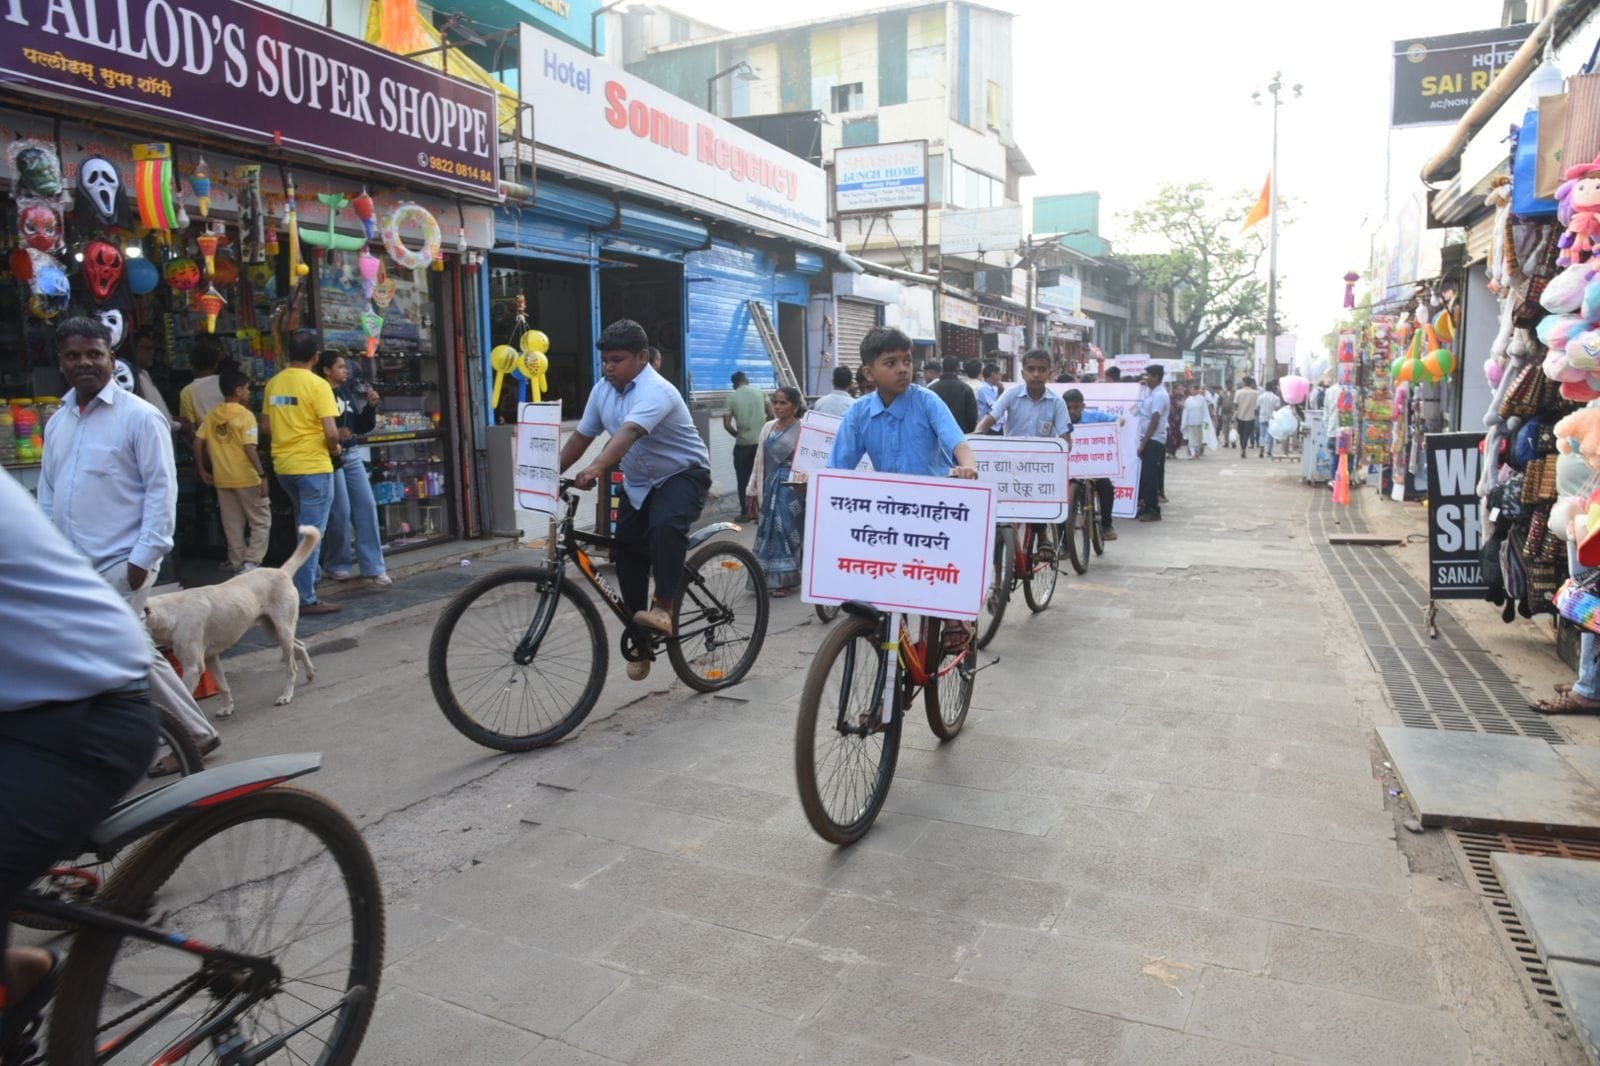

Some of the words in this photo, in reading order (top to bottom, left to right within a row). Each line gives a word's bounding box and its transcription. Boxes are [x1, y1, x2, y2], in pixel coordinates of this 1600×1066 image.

[543, 48, 591, 95] Hotel
[1472, 50, 1517, 67] HOTE
[100, 67, 134, 88] सुपर
[137, 75, 172, 98] शॉपी
[256, 34, 375, 125] SUPER
[379, 77, 489, 158] SHOPPE
[1421, 73, 1463, 96] SAI
[604, 80, 690, 156] Sonu
[696, 121, 799, 201] Regency
[429, 156, 454, 174] 9822
[885, 165, 919, 178] HOME
[1016, 462, 1055, 473] आपला
[1012, 479, 1034, 498] ऐकू
[830, 495, 872, 514] सक्षम
[876, 495, 970, 522] लोकशाहीची
[851, 524, 899, 547] पहिली
[903, 530, 950, 551] पायरी
[837, 557, 897, 579] मतदार
[902, 558, 960, 586] नोंदणी
[594, 572, 619, 603] HERO
